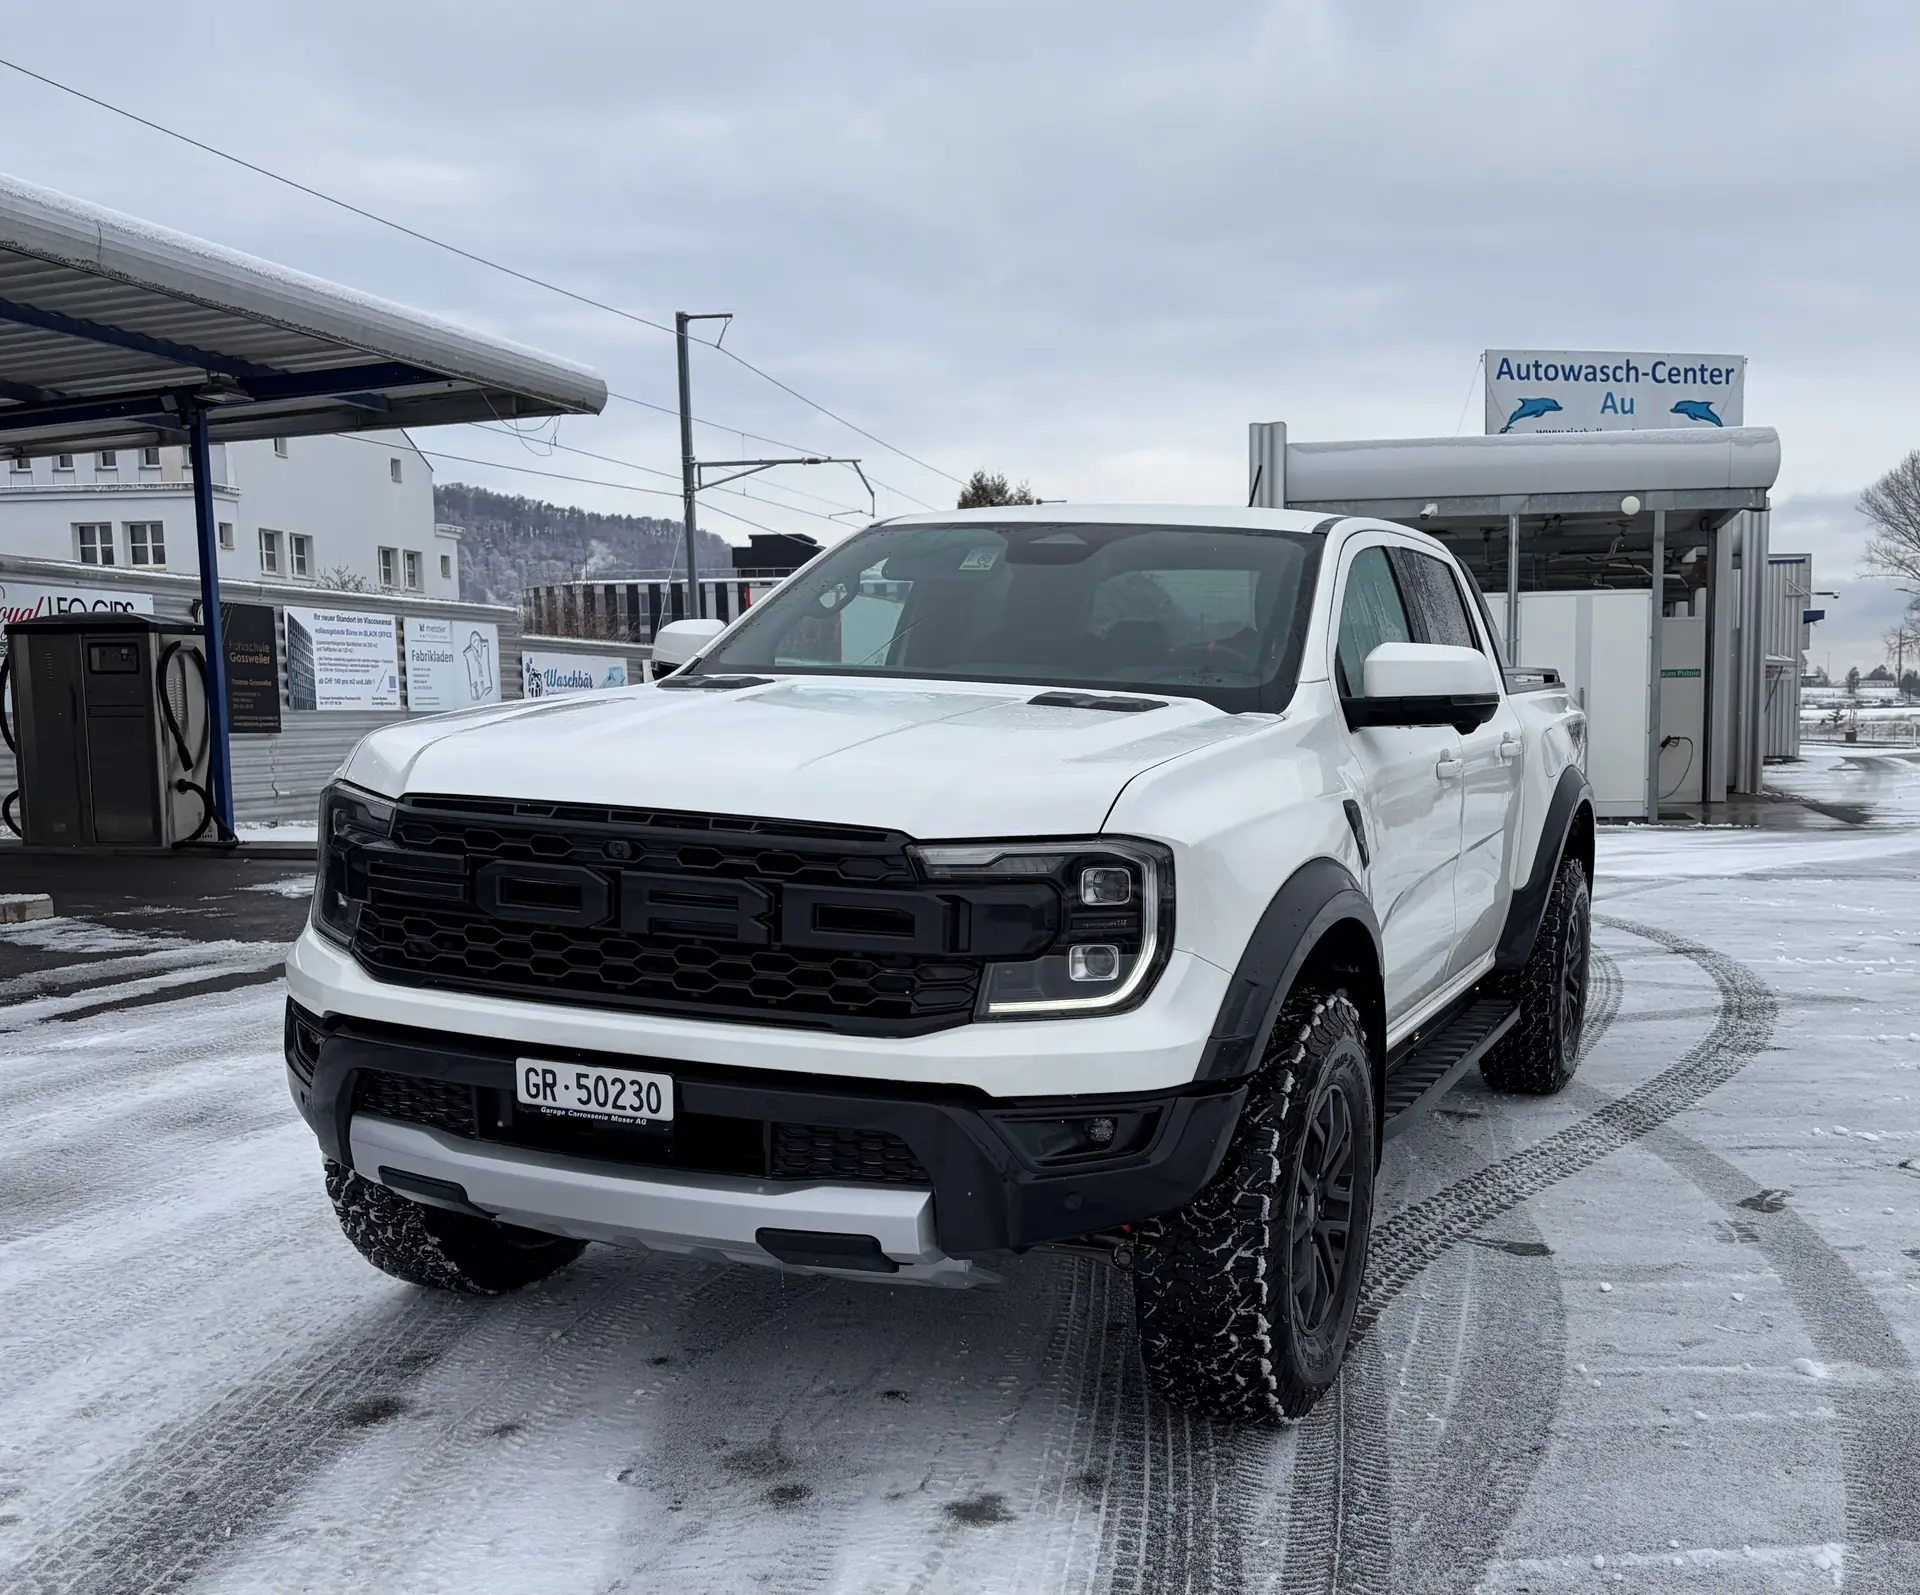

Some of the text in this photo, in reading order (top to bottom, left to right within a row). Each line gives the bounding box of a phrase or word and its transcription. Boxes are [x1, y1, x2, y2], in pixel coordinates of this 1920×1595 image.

[1496, 357, 1735, 385] Autowasch-Center
[1600, 392, 1634, 414] Au
[0, 586, 44, 624] oyal
[229, 651, 270, 664] Gossweiler
[411, 649, 454, 663] Fabrikladen
[543, 669, 594, 689] Waschbär
[1677, 669, 1700, 677] Pistole
[338, 841, 960, 955] FORD
[541, 1106, 647, 1126] Garage Carrosserie Moser AG
